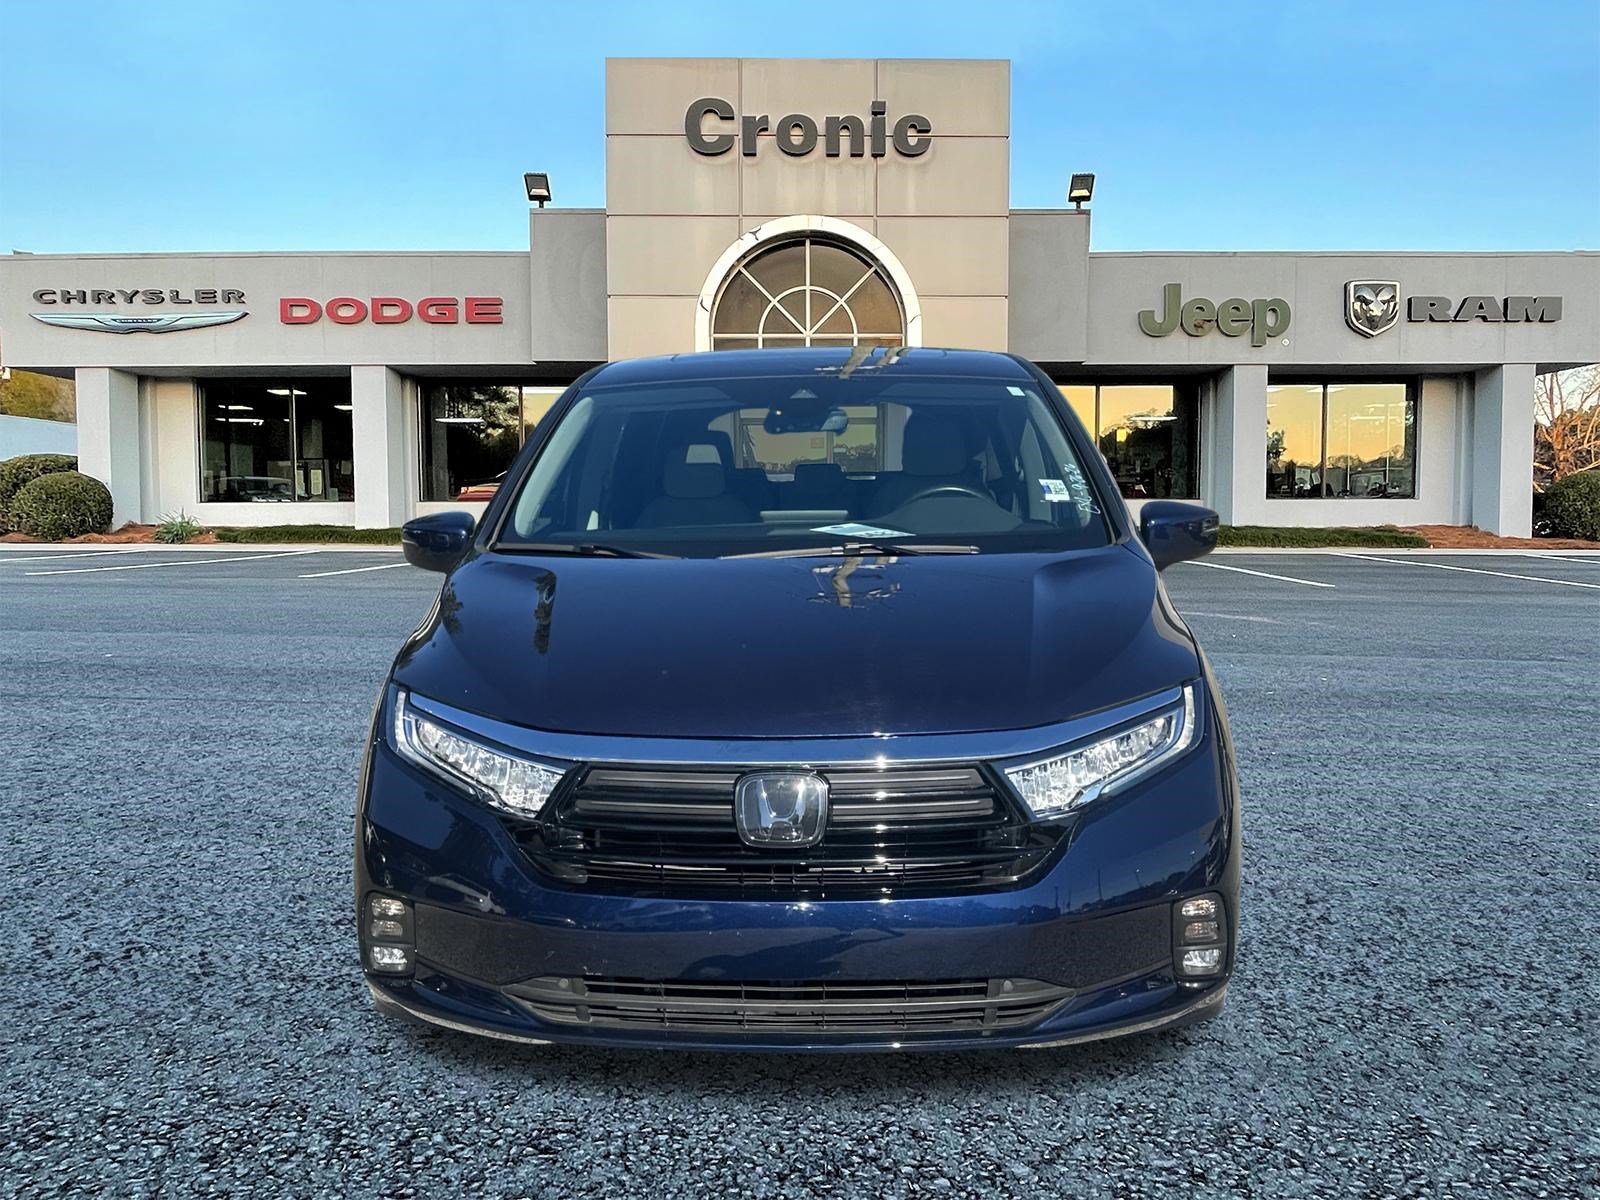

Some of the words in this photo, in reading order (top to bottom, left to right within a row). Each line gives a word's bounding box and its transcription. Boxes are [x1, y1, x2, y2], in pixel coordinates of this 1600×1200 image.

[684, 97, 932, 158] Cronic
[32, 289, 246, 305] CHRYSLER
[280, 297, 504, 325] DODGE
[1407, 296, 1563, 323] RAM
[1138, 283, 1292, 347] Jeep
